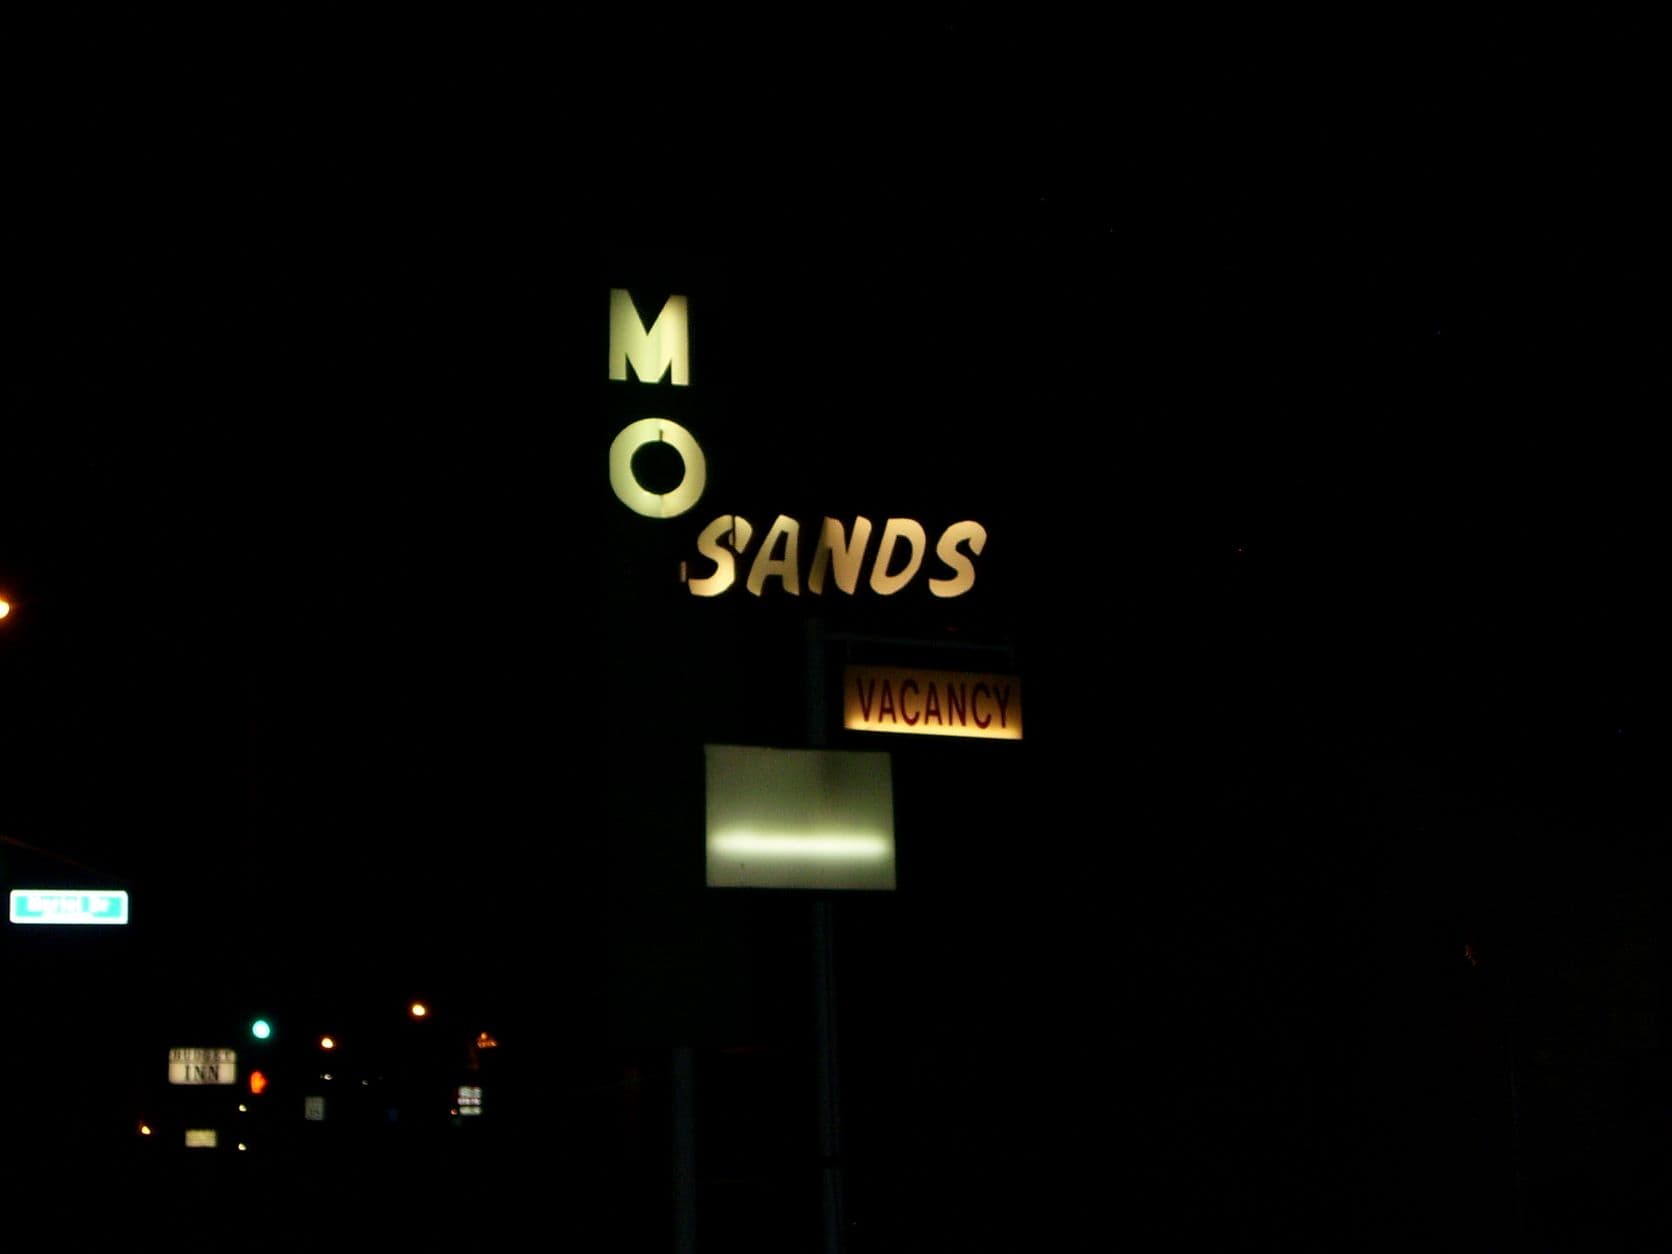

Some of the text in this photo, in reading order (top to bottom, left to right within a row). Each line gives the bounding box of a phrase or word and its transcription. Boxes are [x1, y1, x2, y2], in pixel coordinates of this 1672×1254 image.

[688, 514, 988, 598] SANDS
[855, 678, 1011, 730] VACANCY
[185, 1064, 218, 1081] INN
